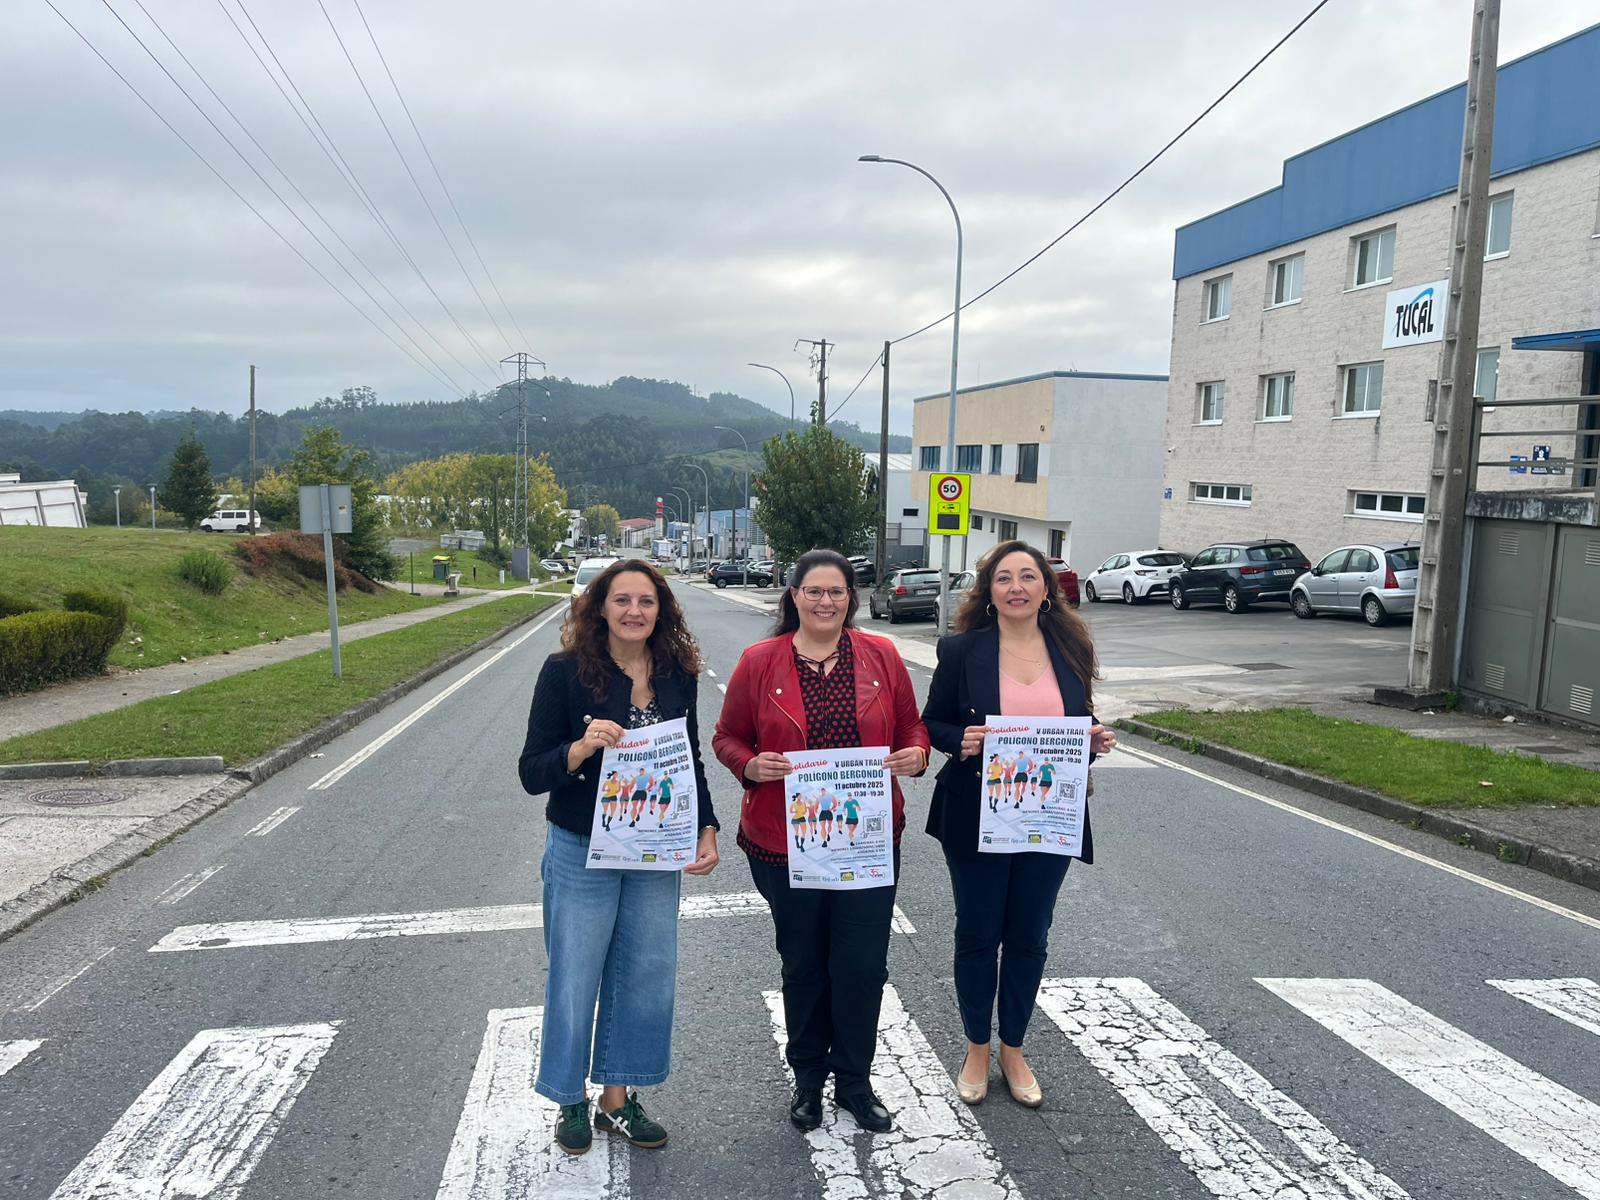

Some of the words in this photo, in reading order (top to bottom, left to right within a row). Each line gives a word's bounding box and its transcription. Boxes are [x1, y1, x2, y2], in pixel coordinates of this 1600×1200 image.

[1396, 299, 1434, 338] TUCAL
[943, 485, 957, 493] 50
[1066, 728, 1084, 736] TRAIL
[998, 736, 1038, 745] POLÍGONO
[1039, 737, 1084, 747] BERGONDO
[658, 742, 687, 758] BERGONDO
[798, 770, 838, 783] POLÍGONO
[840, 769, 884, 780] BERGONDO
